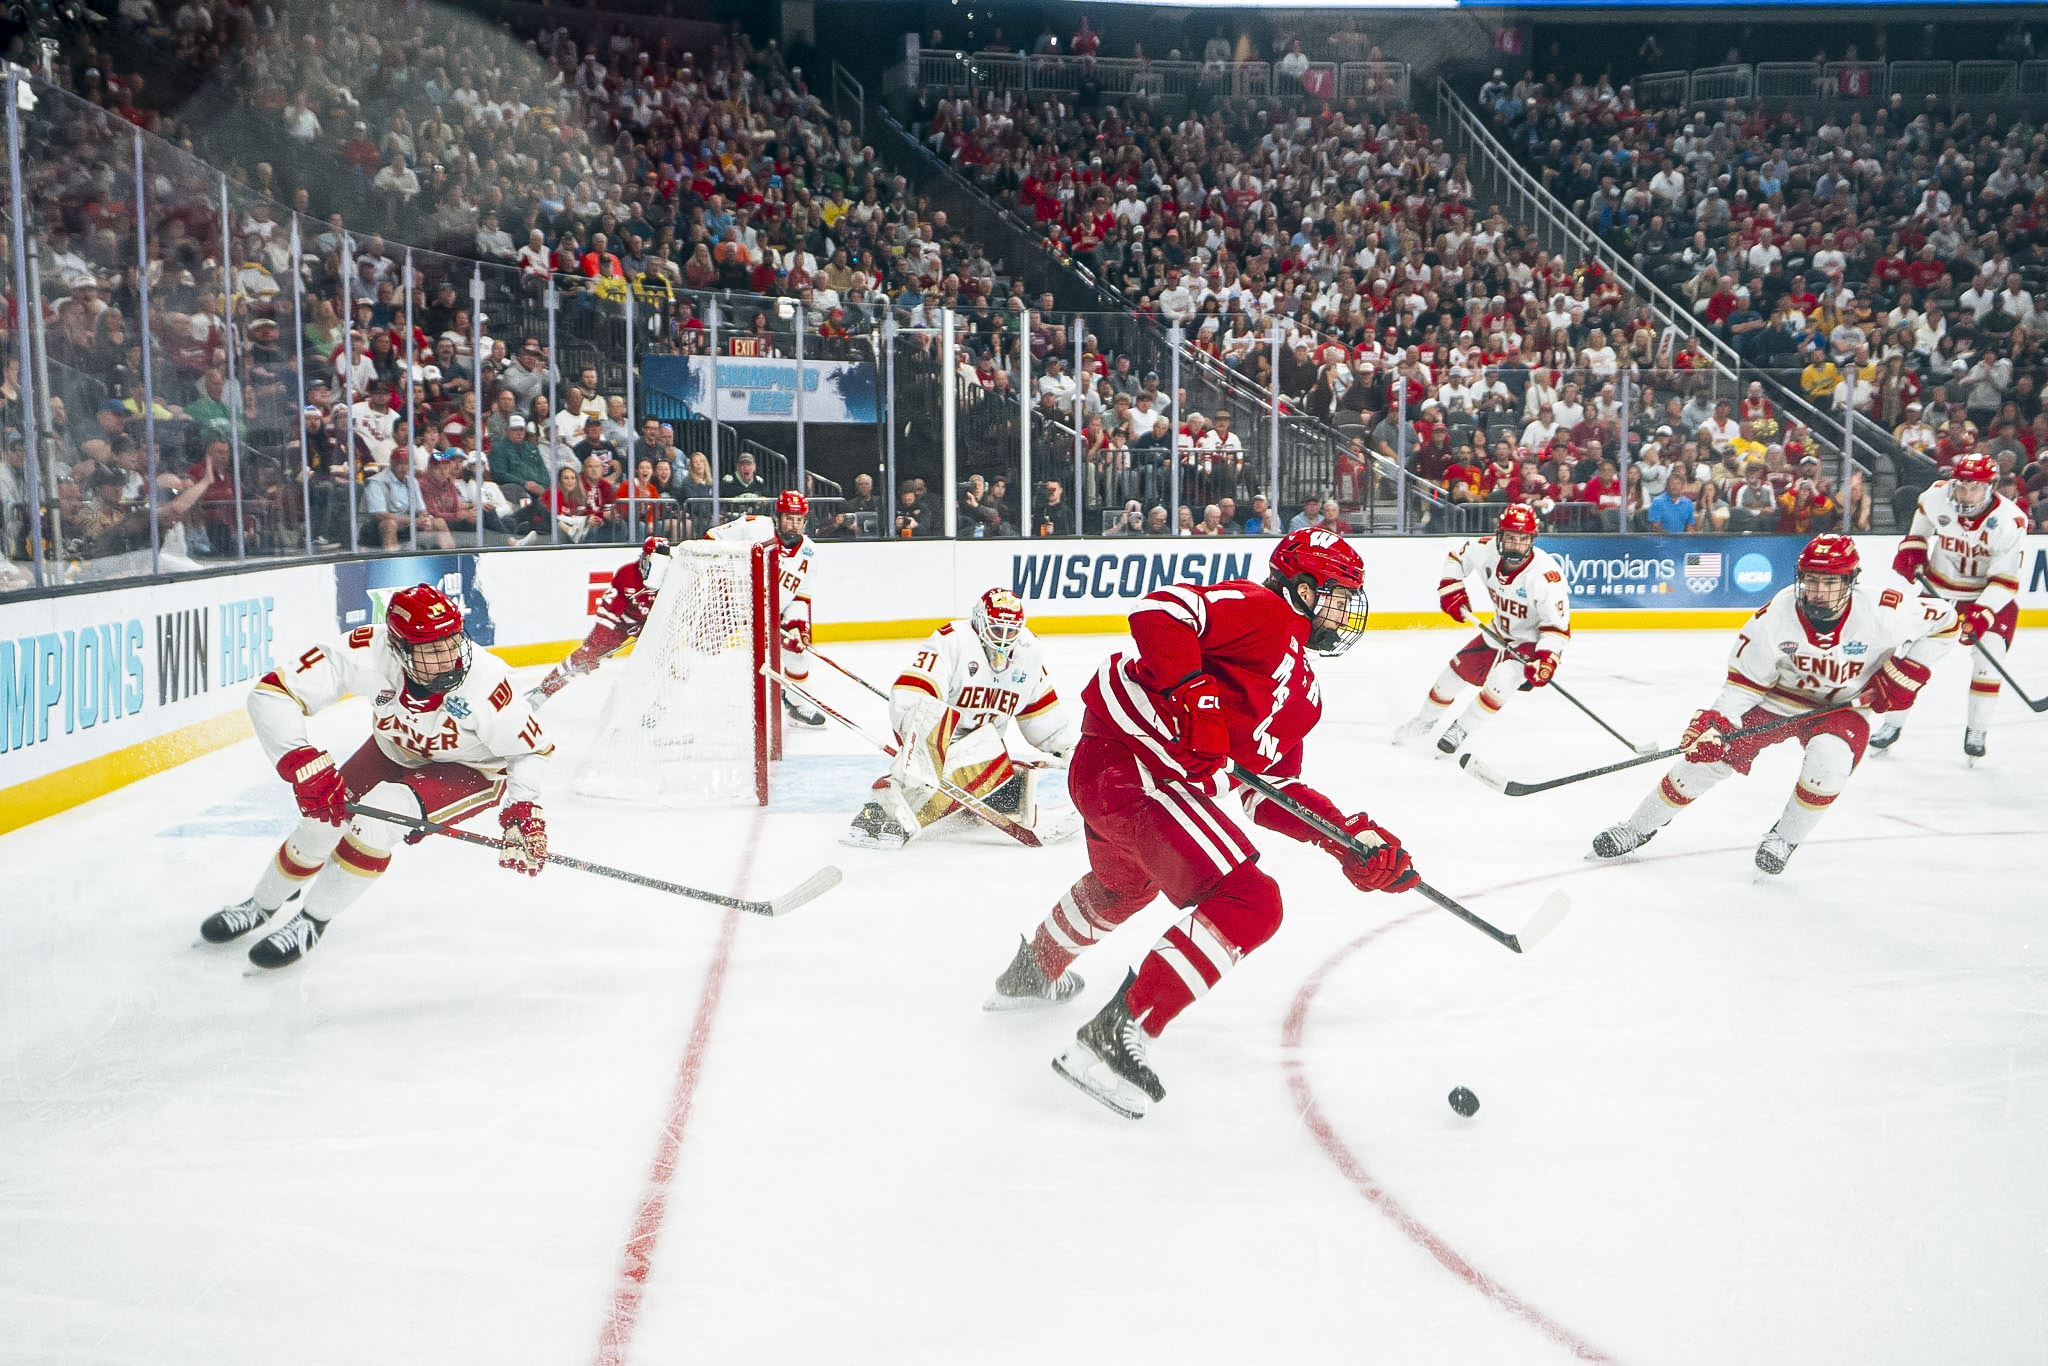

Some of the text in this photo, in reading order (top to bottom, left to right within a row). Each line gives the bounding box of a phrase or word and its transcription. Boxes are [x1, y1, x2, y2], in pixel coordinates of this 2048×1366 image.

[734, 338, 756, 356] EXIT
[715, 364, 819, 391] CHAMPIOS
[1012, 553, 1252, 600] WISCONSIN
[156, 606, 209, 706] WIN
[218, 596, 275, 687] HERE
[912, 651, 939, 673] 31
[955, 686, 1020, 718] DENVER
[374, 713, 459, 751] ENVER
